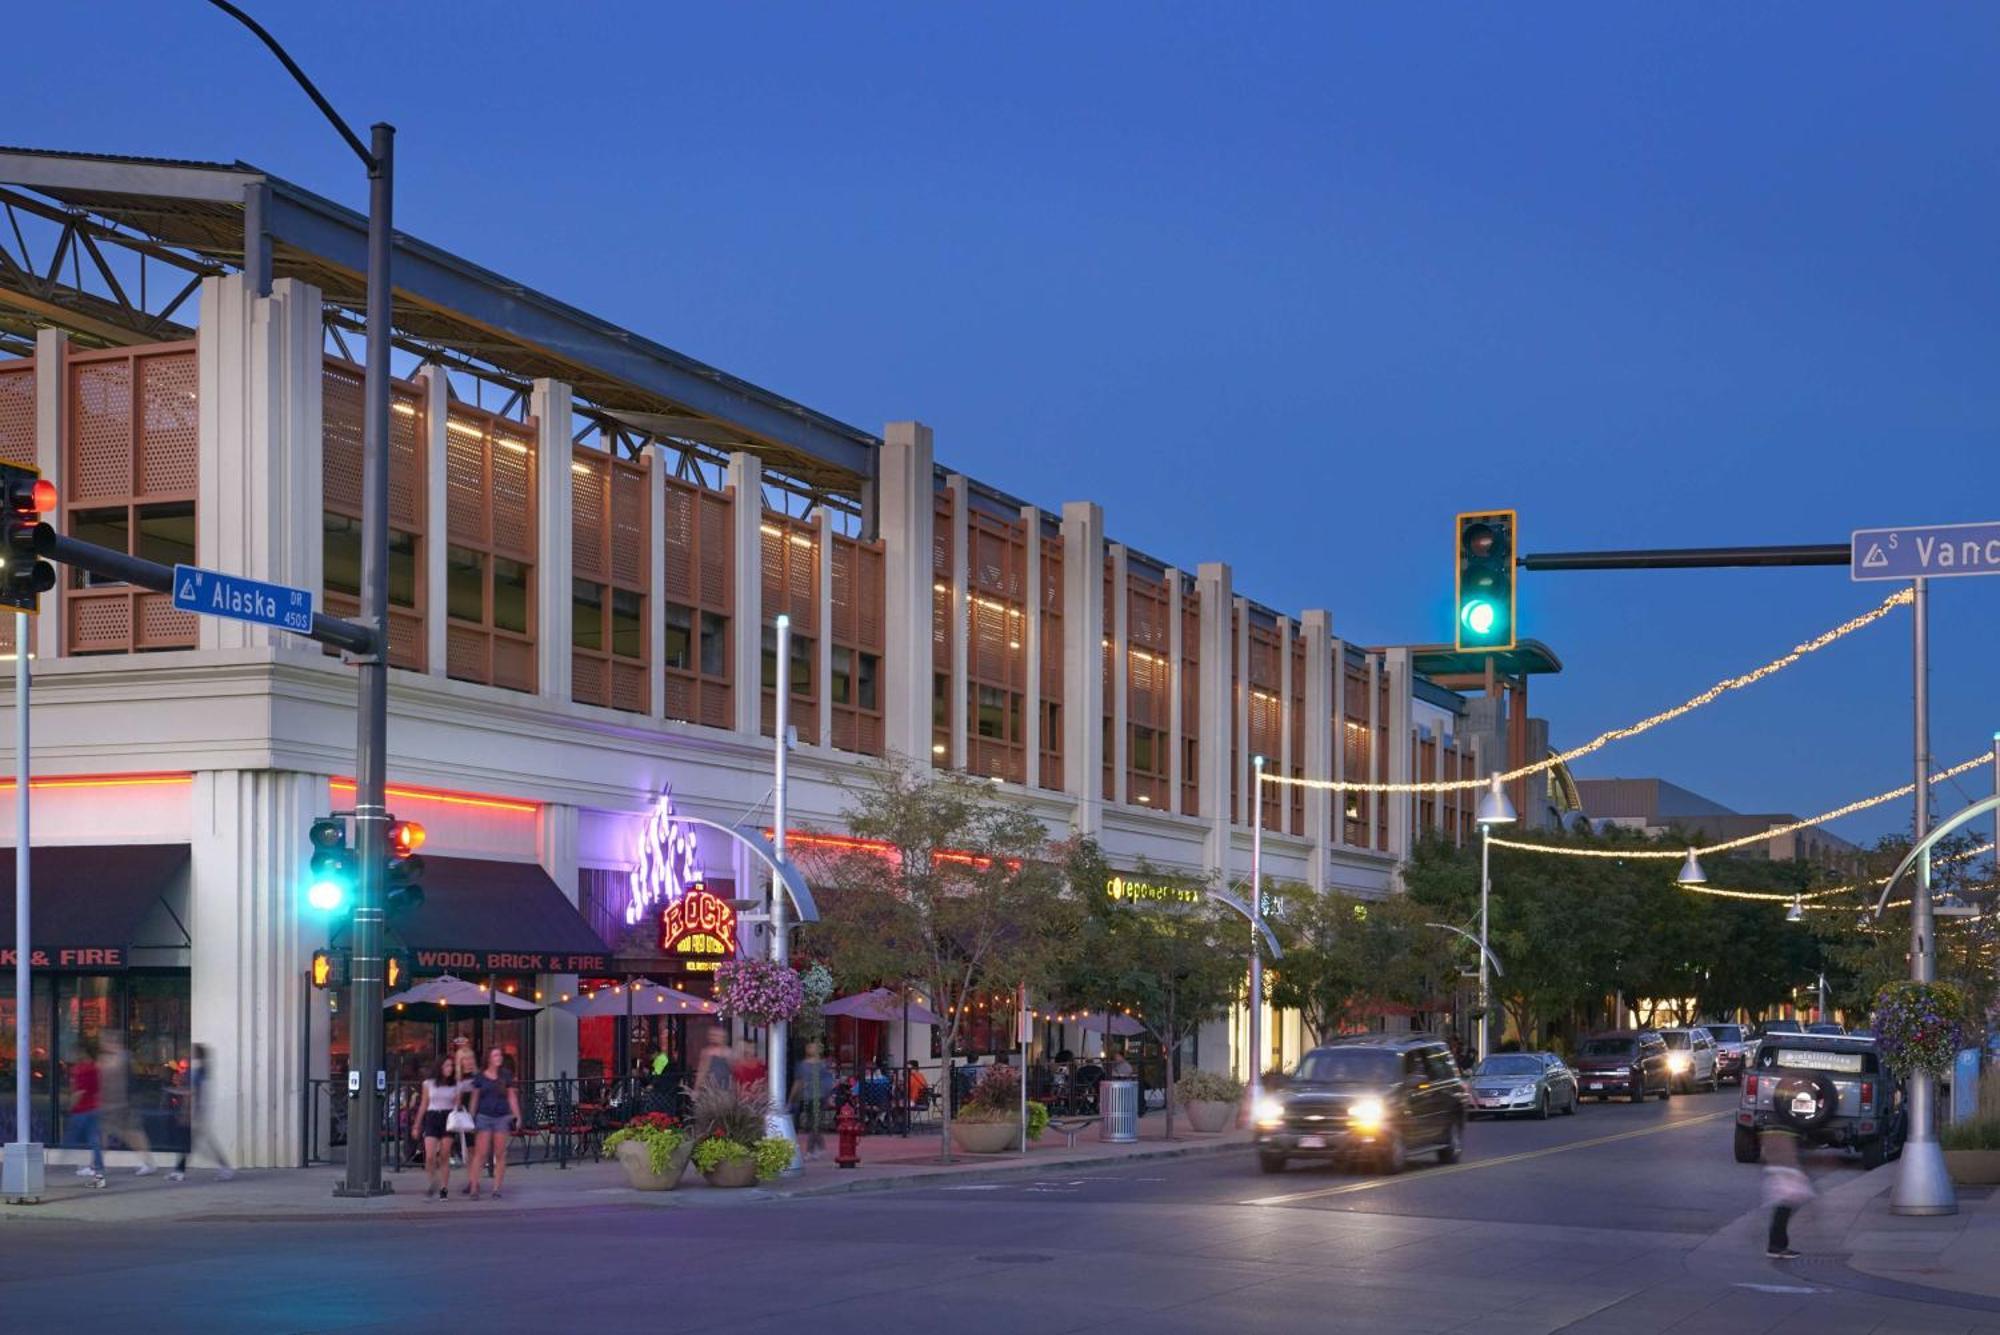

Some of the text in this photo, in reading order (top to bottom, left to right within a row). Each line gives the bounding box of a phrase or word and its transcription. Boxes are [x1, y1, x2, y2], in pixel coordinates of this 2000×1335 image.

[1889, 533, 2000, 567] S Vanc
[195, 573, 302, 618] W Alaska DR
[664, 892, 735, 952] ROCK
[31, 950, 50, 966] &
[60, 949, 121, 966] FIRE
[417, 952, 604, 970] WOOD, BRICK & FIRE
